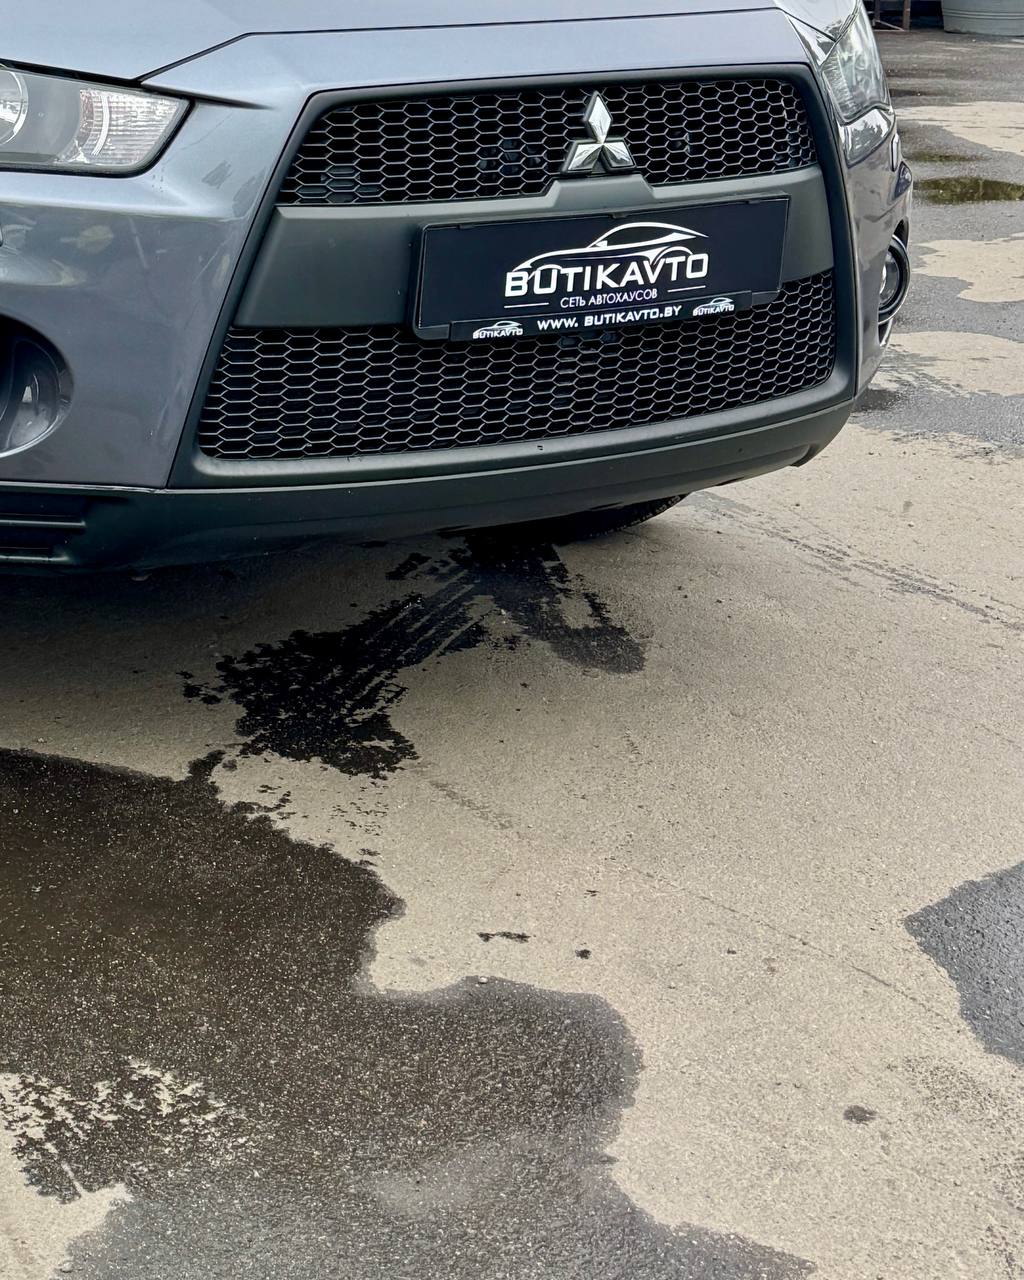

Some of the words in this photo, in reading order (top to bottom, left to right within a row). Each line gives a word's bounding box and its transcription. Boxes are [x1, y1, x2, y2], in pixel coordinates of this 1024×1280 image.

[504, 252, 709, 297] BUTIKAVTO
[560, 295, 586, 309] СЕТЬ
[588, 288, 658, 306] АВТОХАУСОВ
[537, 316, 579, 331] WWW.
[584, 305, 682, 327] BUTIKAVTO.BY
[692, 303, 735, 317] BUTIKAVTO
[472, 327, 524, 340] BUTIKAVTO
